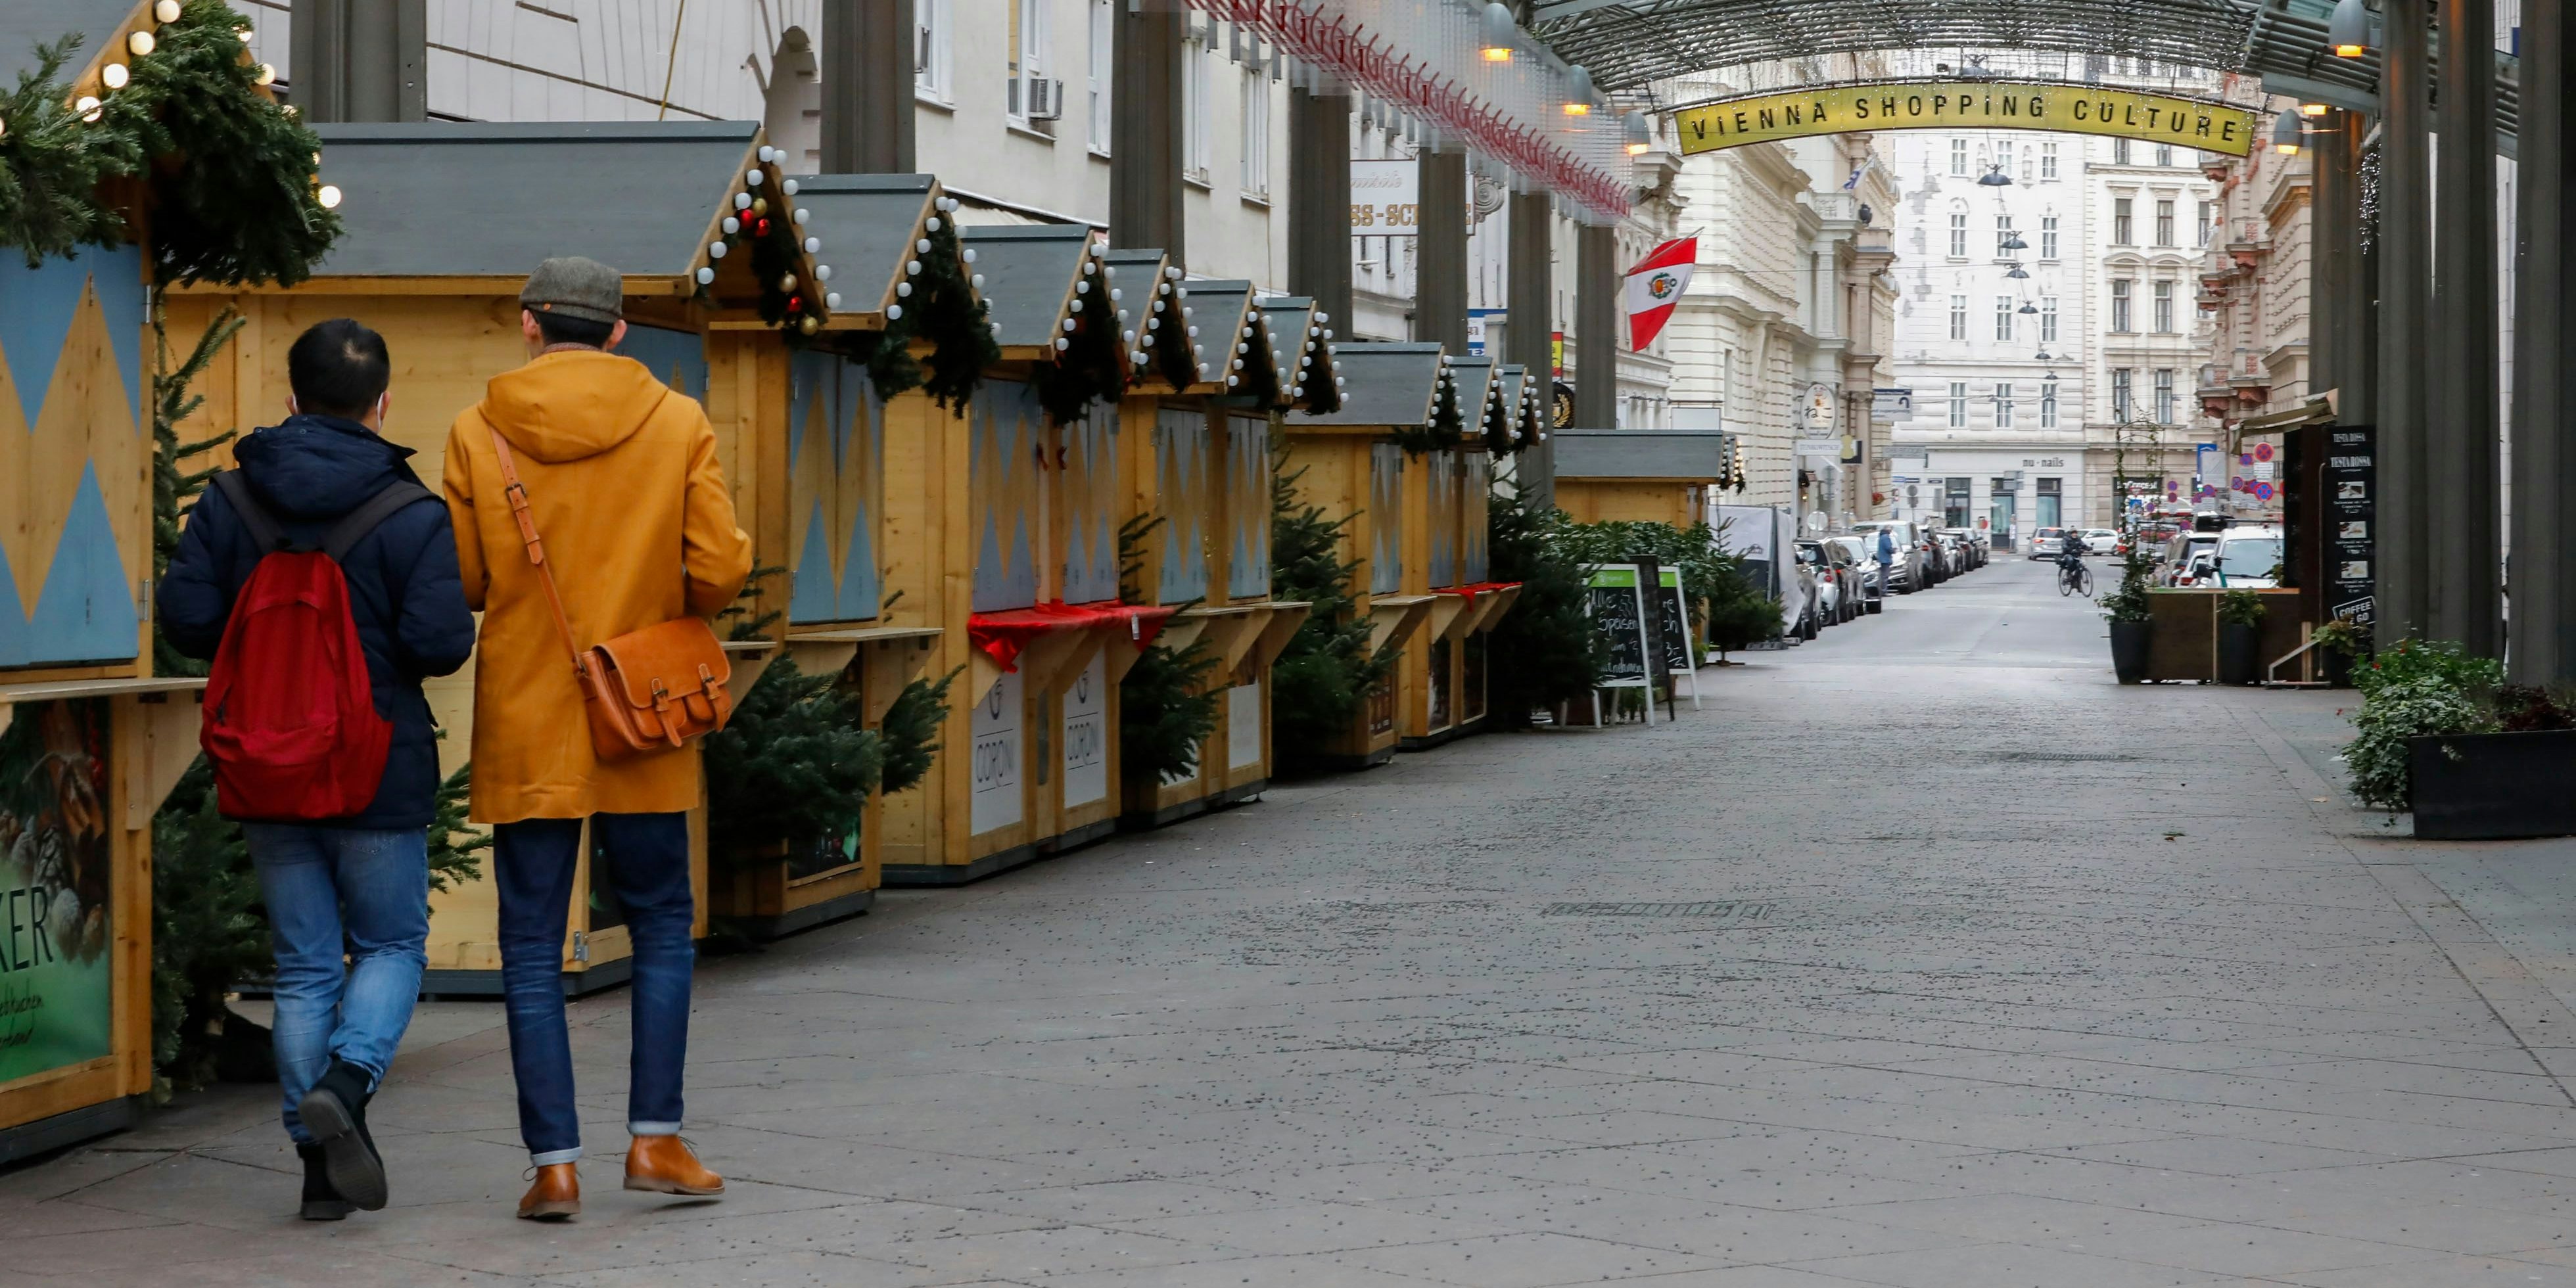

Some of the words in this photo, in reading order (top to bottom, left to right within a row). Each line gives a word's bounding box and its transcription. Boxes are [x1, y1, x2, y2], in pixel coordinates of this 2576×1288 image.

[2074, 99, 2237, 142] CULTURE
[1804, 405, 1833, 419] ねこ
[2041, 457, 2064, 467] nails
[2351, 456, 2372, 467] ROSSA
[2339, 601, 2372, 617] COFFEE
[0, 886, 53, 973] ER
